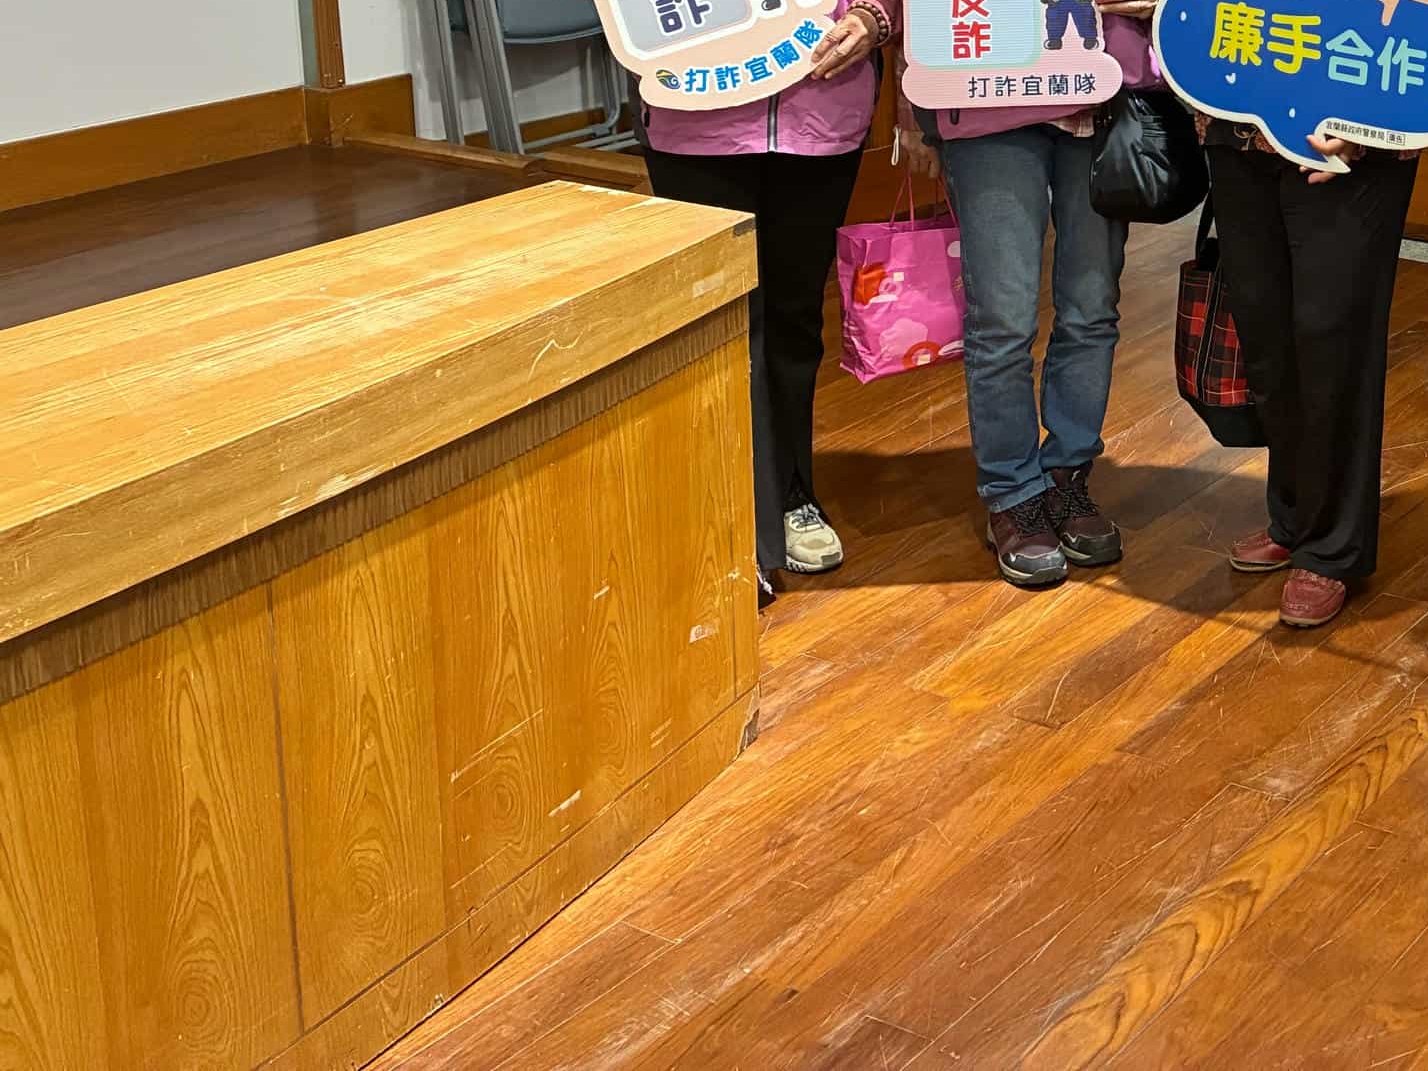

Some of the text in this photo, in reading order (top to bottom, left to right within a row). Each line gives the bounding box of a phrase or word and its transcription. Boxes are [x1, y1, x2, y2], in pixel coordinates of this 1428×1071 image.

[684, 20, 823, 92] 打詐宜蘭隊
[1209, 1, 1428, 95] 廉手合作
[968, 73, 1097, 98] 打詐宜蘭隊
